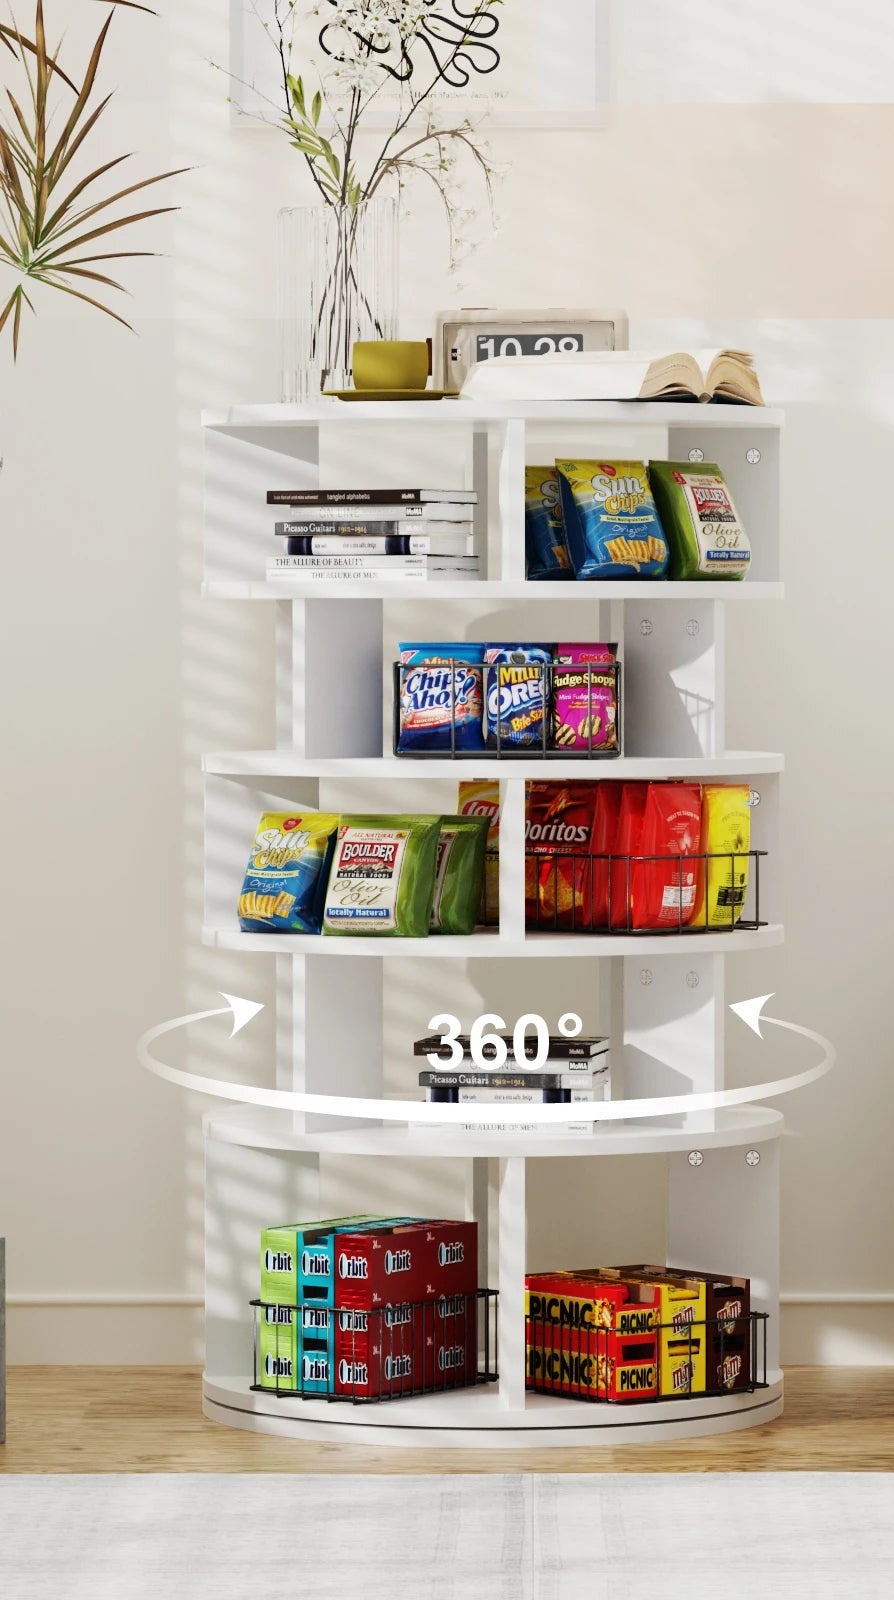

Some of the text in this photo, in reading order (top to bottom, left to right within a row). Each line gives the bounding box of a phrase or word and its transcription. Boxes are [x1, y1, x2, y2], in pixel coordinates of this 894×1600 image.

[591, 474, 645, 502] Sun
[692, 487, 730, 506] BOULDER
[604, 493, 646, 515] Chips
[283, 523, 308, 533] Picasso
[309, 522, 336, 533] Guitars
[702, 523, 741, 536] Olive
[714, 536, 739, 549] Oil
[275, 558, 363, 566] THE ALLURE OF BEAUTY
[710, 551, 729, 559] Totally
[406, 669, 467, 695] Chips
[582, 672, 616, 687] Shopp
[488, 679, 549, 715] OREO
[510, 713, 532, 732] Bite
[251, 828, 311, 856] Sun
[341, 843, 395, 862] BOULDER
[253, 847, 303, 869] Chips
[249, 879, 288, 893] Original
[332, 879, 392, 893] Olive
[339, 892, 382, 906] Oil
[328, 908, 387, 917] Totally Natural
[429, 1073, 458, 1084] Picasso
[458, 1074, 489, 1085] Guitars
[265, 1248, 293, 1273] Orbit
[301, 1250, 331, 1276] Orbit
[384, 1249, 411, 1275] Orbit
[438, 1242, 464, 1267] Orbit
[338, 1253, 369, 1279] Orbit
[529, 1295, 593, 1330] PICNIC
[620, 1311, 653, 1335] PICNIC
[265, 1352, 293, 1378] Orbit
[338, 1358, 369, 1385] Orbit
[384, 1355, 412, 1381] Orbit
[529, 1348, 593, 1385] PICNIC
[620, 1367, 653, 1390] PICNIC
